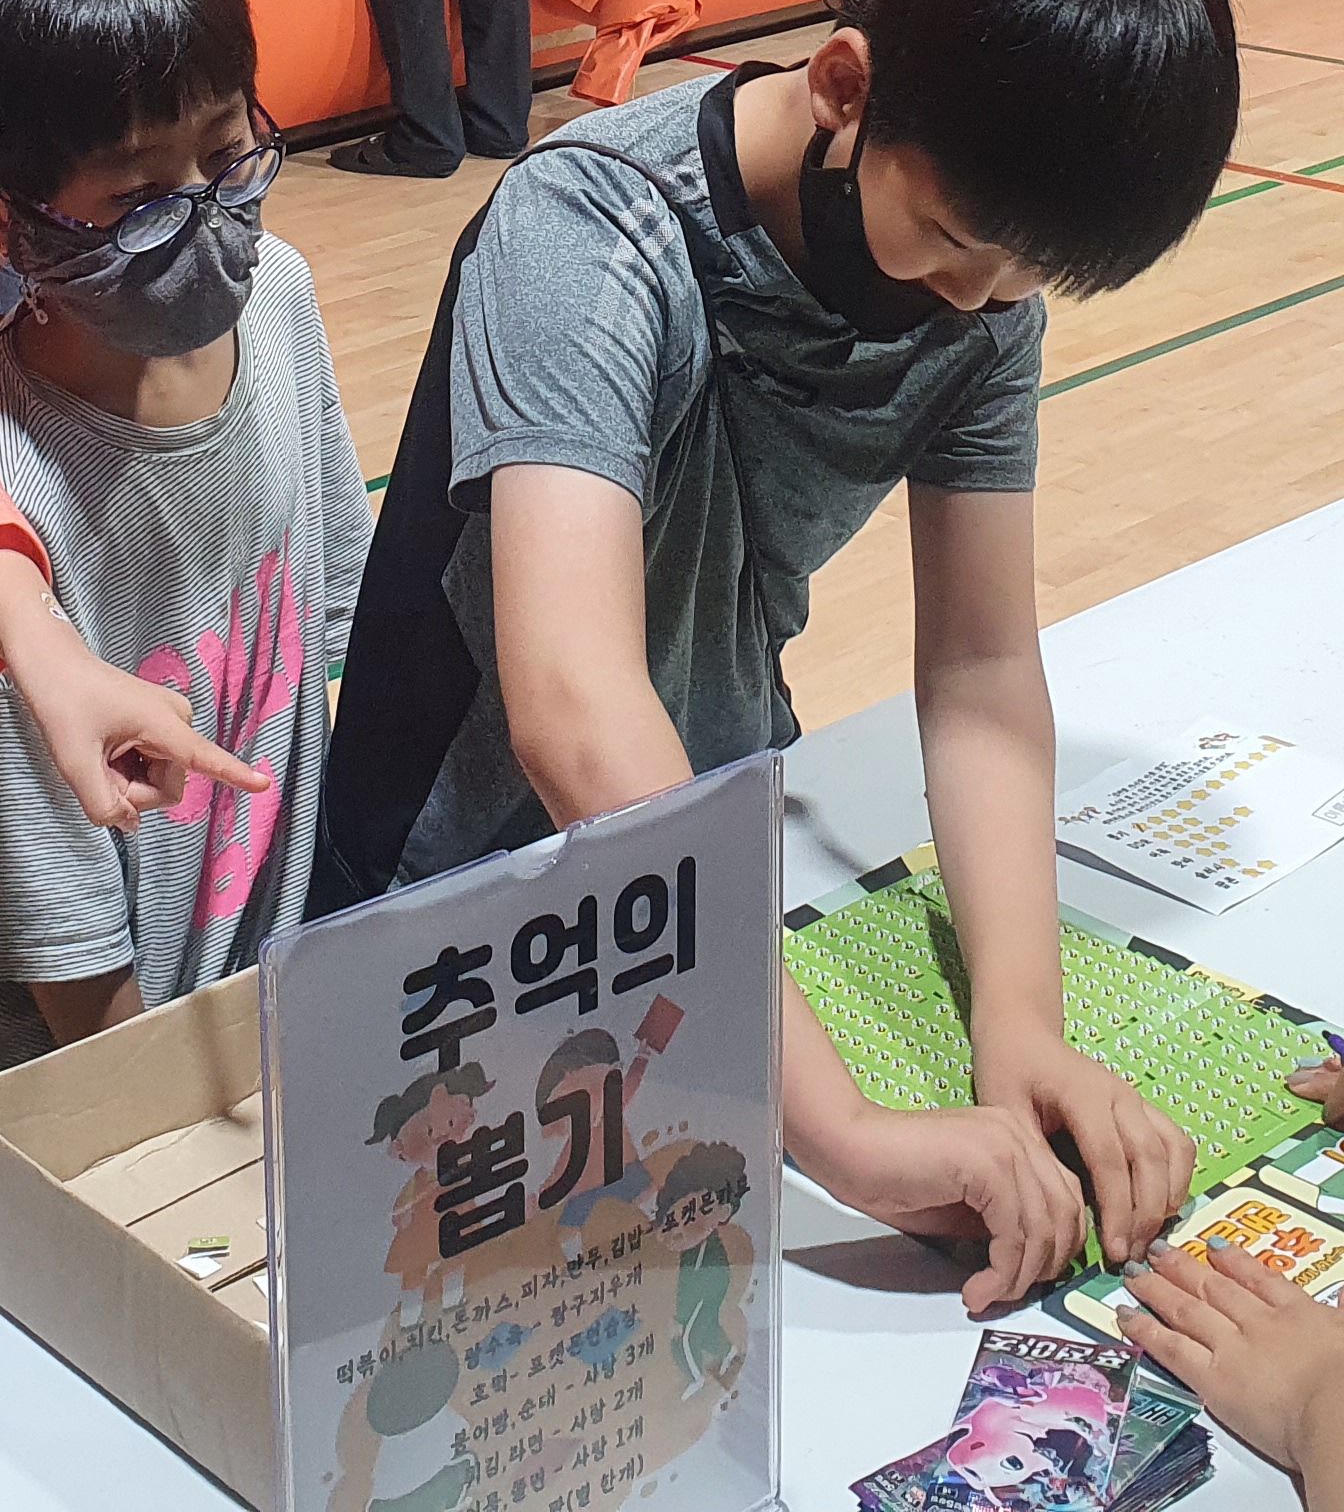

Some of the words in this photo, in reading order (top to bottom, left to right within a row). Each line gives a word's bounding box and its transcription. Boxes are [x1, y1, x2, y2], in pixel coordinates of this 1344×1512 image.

[399, 855, 698, 1074] 추억의
[433, 1066, 624, 1260] 뽑기
[583, 1353, 618, 1387] 사탕
[625, 1333, 655, 1367] 3개
[982, 1332, 1130, 1370] 퓨전아츠
[570, 1398, 606, 1433] 사탕
[613, 1377, 644, 1413] 2개
[572, 1434, 608, 1470] 사탕
[615, 1414, 644, 1449] 1개
